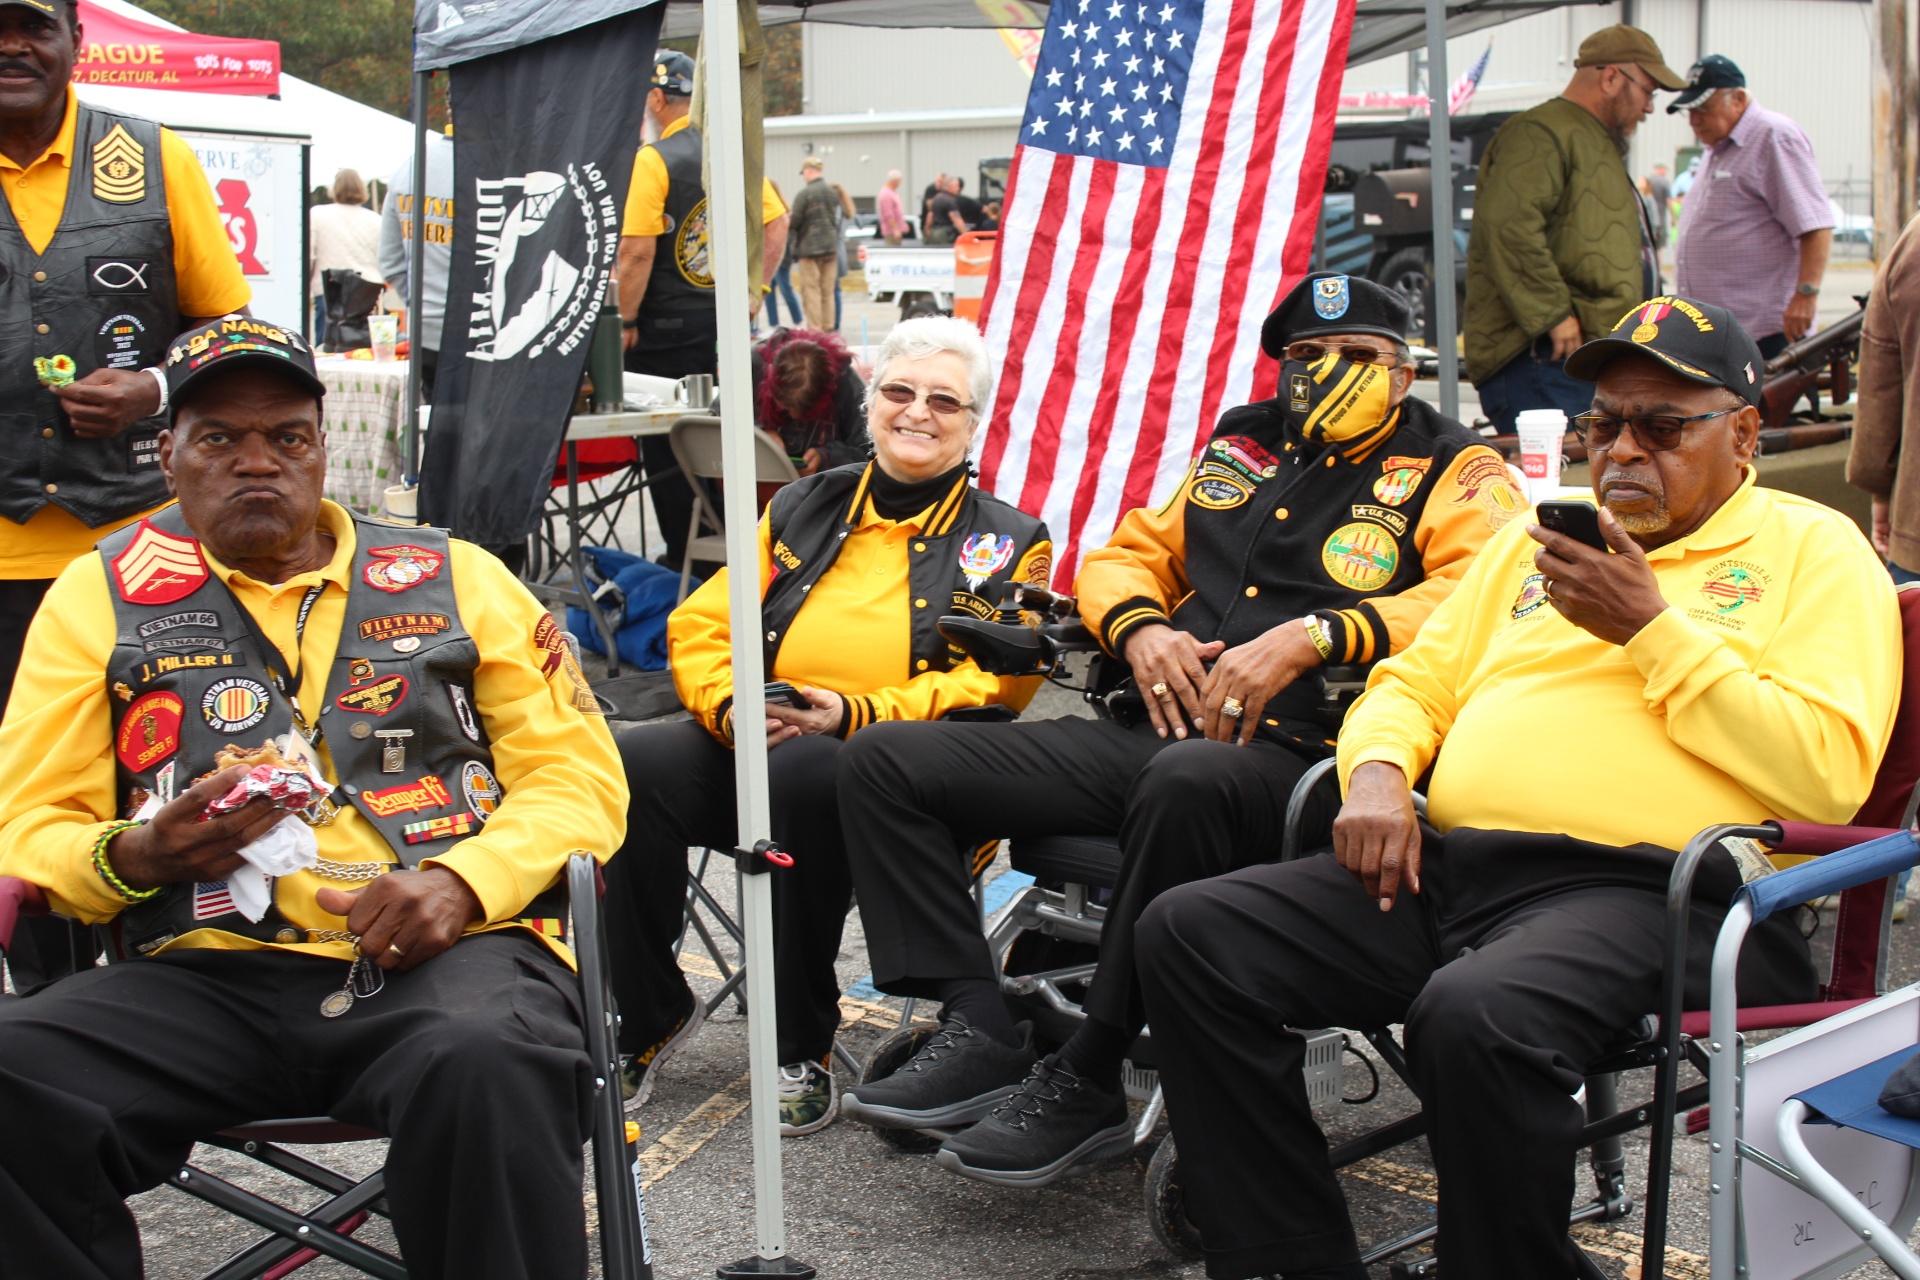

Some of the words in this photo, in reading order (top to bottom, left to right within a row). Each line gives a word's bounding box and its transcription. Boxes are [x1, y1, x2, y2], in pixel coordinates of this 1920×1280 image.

[223, 57, 243, 71] FOR
[247, 59, 273, 74] TOTS
[89, 71, 159, 84] DECATUR,
[161, 72, 180, 83] AL
[1671, 299, 1714, 332] VETERAN
[189, 329, 218, 349] DA
[221, 320, 283, 337] NANG
[1328, 407, 1347, 427] PROUD
[1345, 392, 1361, 408] ARMY
[1358, 369, 1378, 393] VETERAN
[1207, 464, 1234, 478] SERGEANT
[1214, 450, 1233, 463] UNITED
[1248, 472, 1264, 483] ARMY
[1457, 459, 1481, 482] HONOR
[1205, 488, 1232, 499] RETIRED
[1219, 483, 1240, 494] ARMY
[1368, 509, 1384, 518] U.S.
[1383, 514, 1406, 531] ARMY
[1705, 560, 1765, 577] HUNTSVILLE
[1762, 574, 1772, 585] AL
[953, 595, 967, 605] U.S.
[967, 599, 990, 615] ARMY
[141, 613, 197, 634] VIETNAM
[200, 614, 214, 624] 66
[362, 615, 446, 634] VIETNAM
[1688, 608, 1726, 620] CHAPTER
[1727, 617, 1746, 627] 1067
[1706, 617, 1742, 631] MEMBER
[147, 638, 205, 649] VIETNAM
[207, 639, 221, 647] 67
[141, 663, 156, 682] J.
[157, 655, 218, 674] MILLER
[222, 654, 233, 665] II
[201, 679, 235, 708] VIETNAM
[236, 679, 270, 702] VETERAN
[362, 694, 393, 710] JESUS
[209, 717, 224, 730] US
[223, 712, 264, 732] MARINES
[137, 741, 166, 765] SEMPER
[165, 736, 173, 747] FI
[362, 790, 430, 812] Semper
[418, 775, 448, 806] Fi
